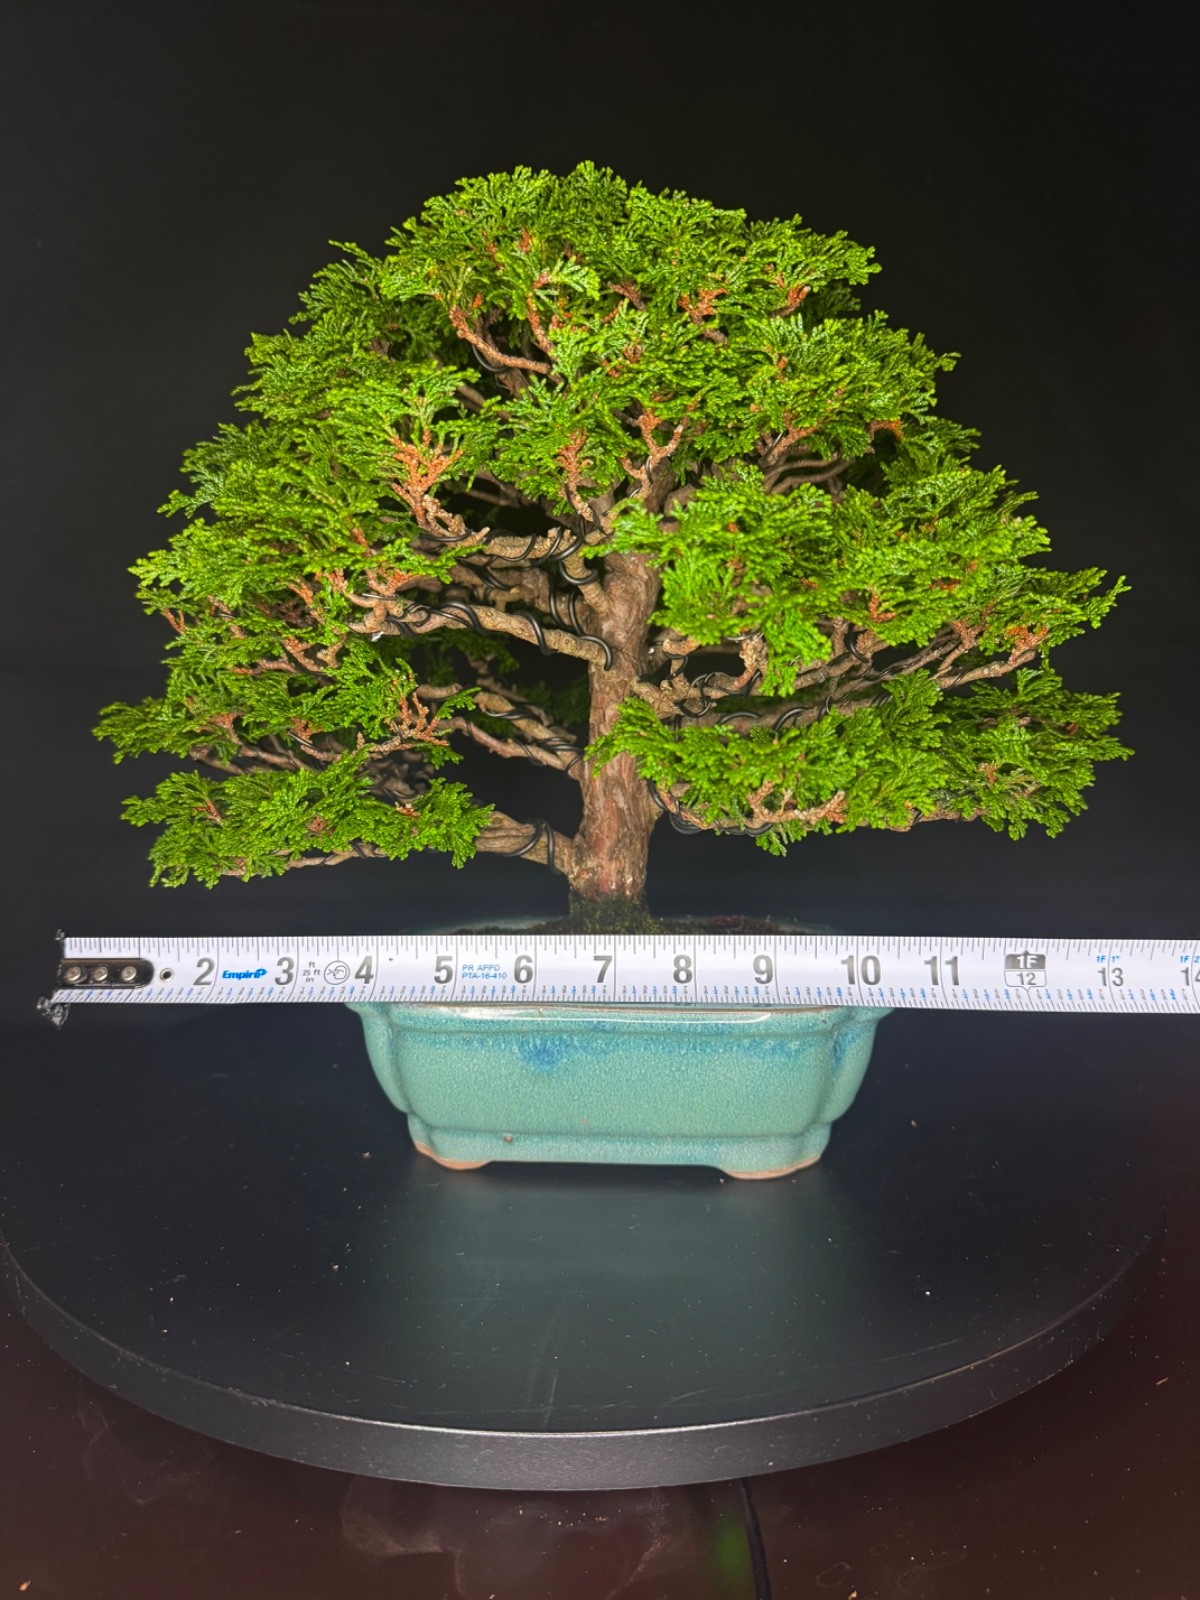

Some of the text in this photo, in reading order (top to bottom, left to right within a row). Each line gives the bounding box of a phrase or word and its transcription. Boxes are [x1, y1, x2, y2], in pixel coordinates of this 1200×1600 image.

[193, 957, 215, 986] 2
[222, 968, 268, 980] Empire
[274, 956, 295, 986] 3
[354, 955, 374, 984] 4
[433, 955, 454, 984] 5
[513, 955, 534, 984] 6
[593, 955, 613, 984] 7
[672, 954, 693, 984] 8
[752, 954, 774, 985] 9
[841, 955, 882, 986] 10
[923, 955, 960, 986] 11
[1016, 955, 1038, 969] 1F
[1016, 972, 1037, 986] 12
[1097, 967, 1124, 987] 13
